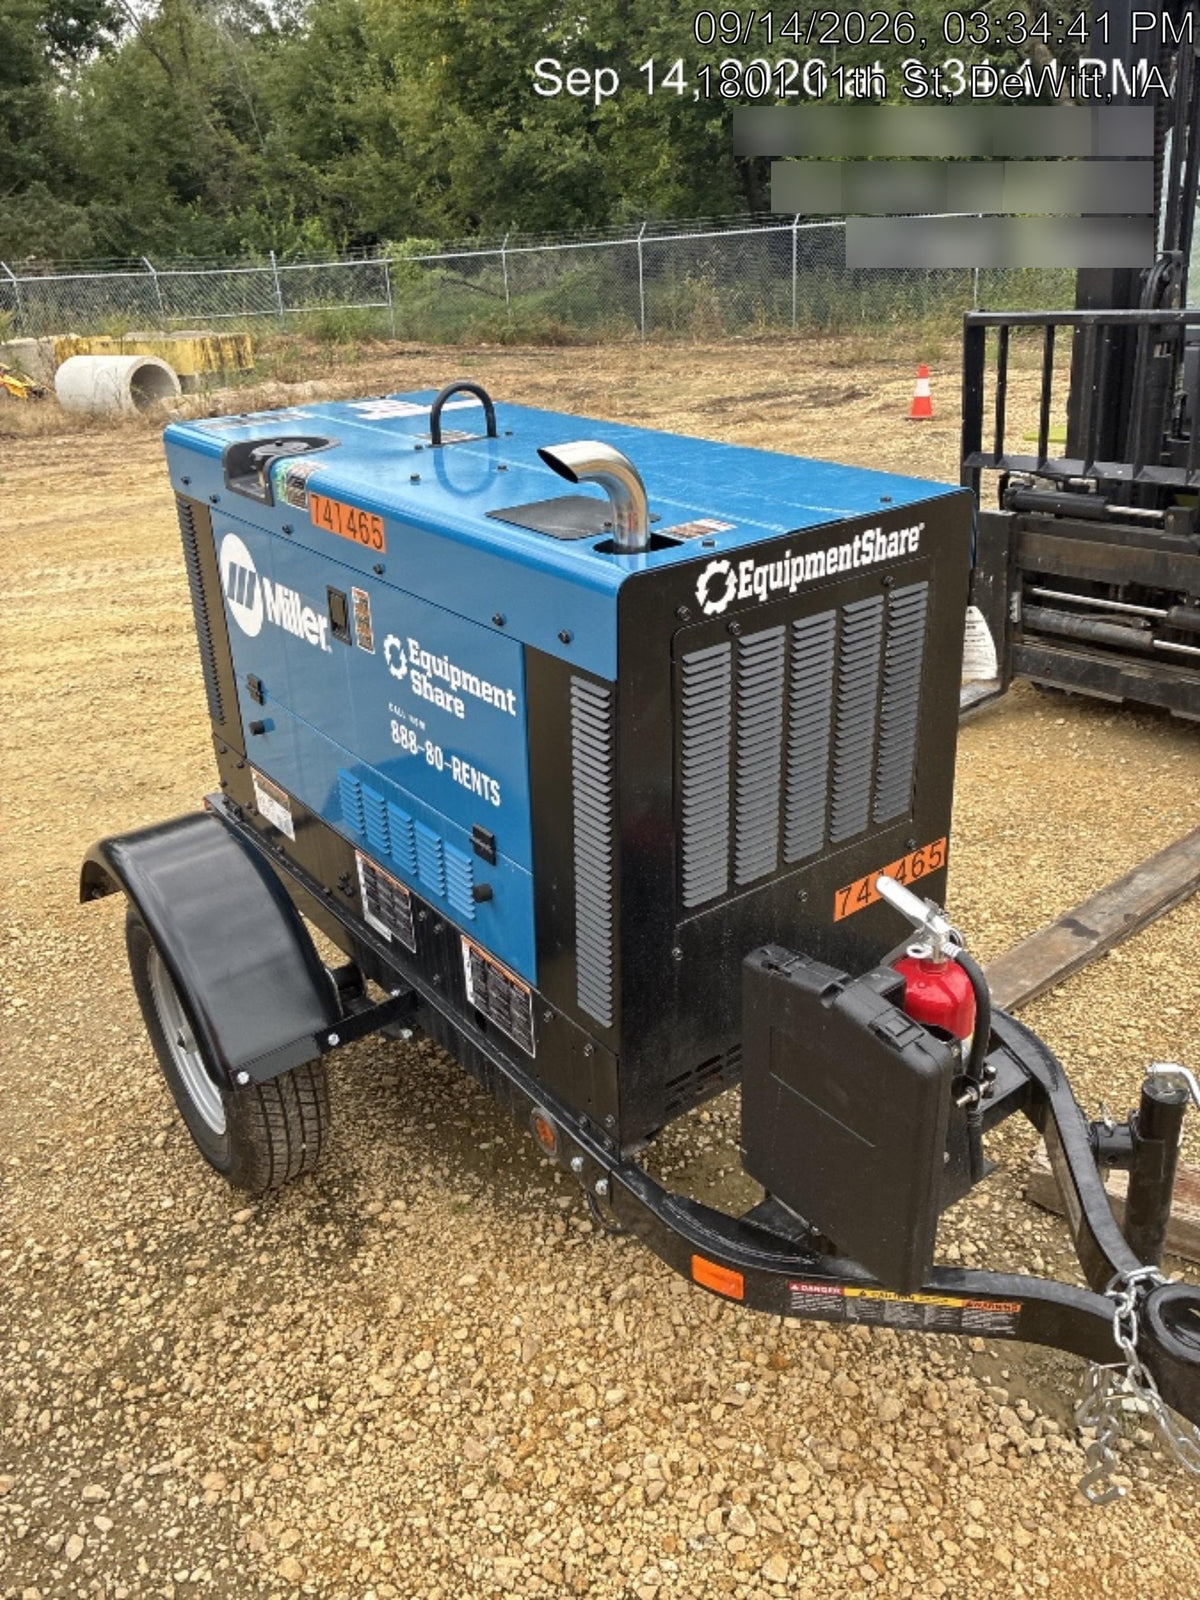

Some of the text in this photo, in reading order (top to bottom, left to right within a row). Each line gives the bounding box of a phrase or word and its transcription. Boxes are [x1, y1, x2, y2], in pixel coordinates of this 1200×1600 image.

[310, 493, 384, 551] 741465
[261, 576, 329, 651] Miller
[406, 637, 517, 717] Equipment
[410, 668, 466, 720] Share
[390, 719, 502, 807] 888-80-RENTS
[837, 840, 943, 917] 74465
[800, 1284, 842, 1295] DANGER
